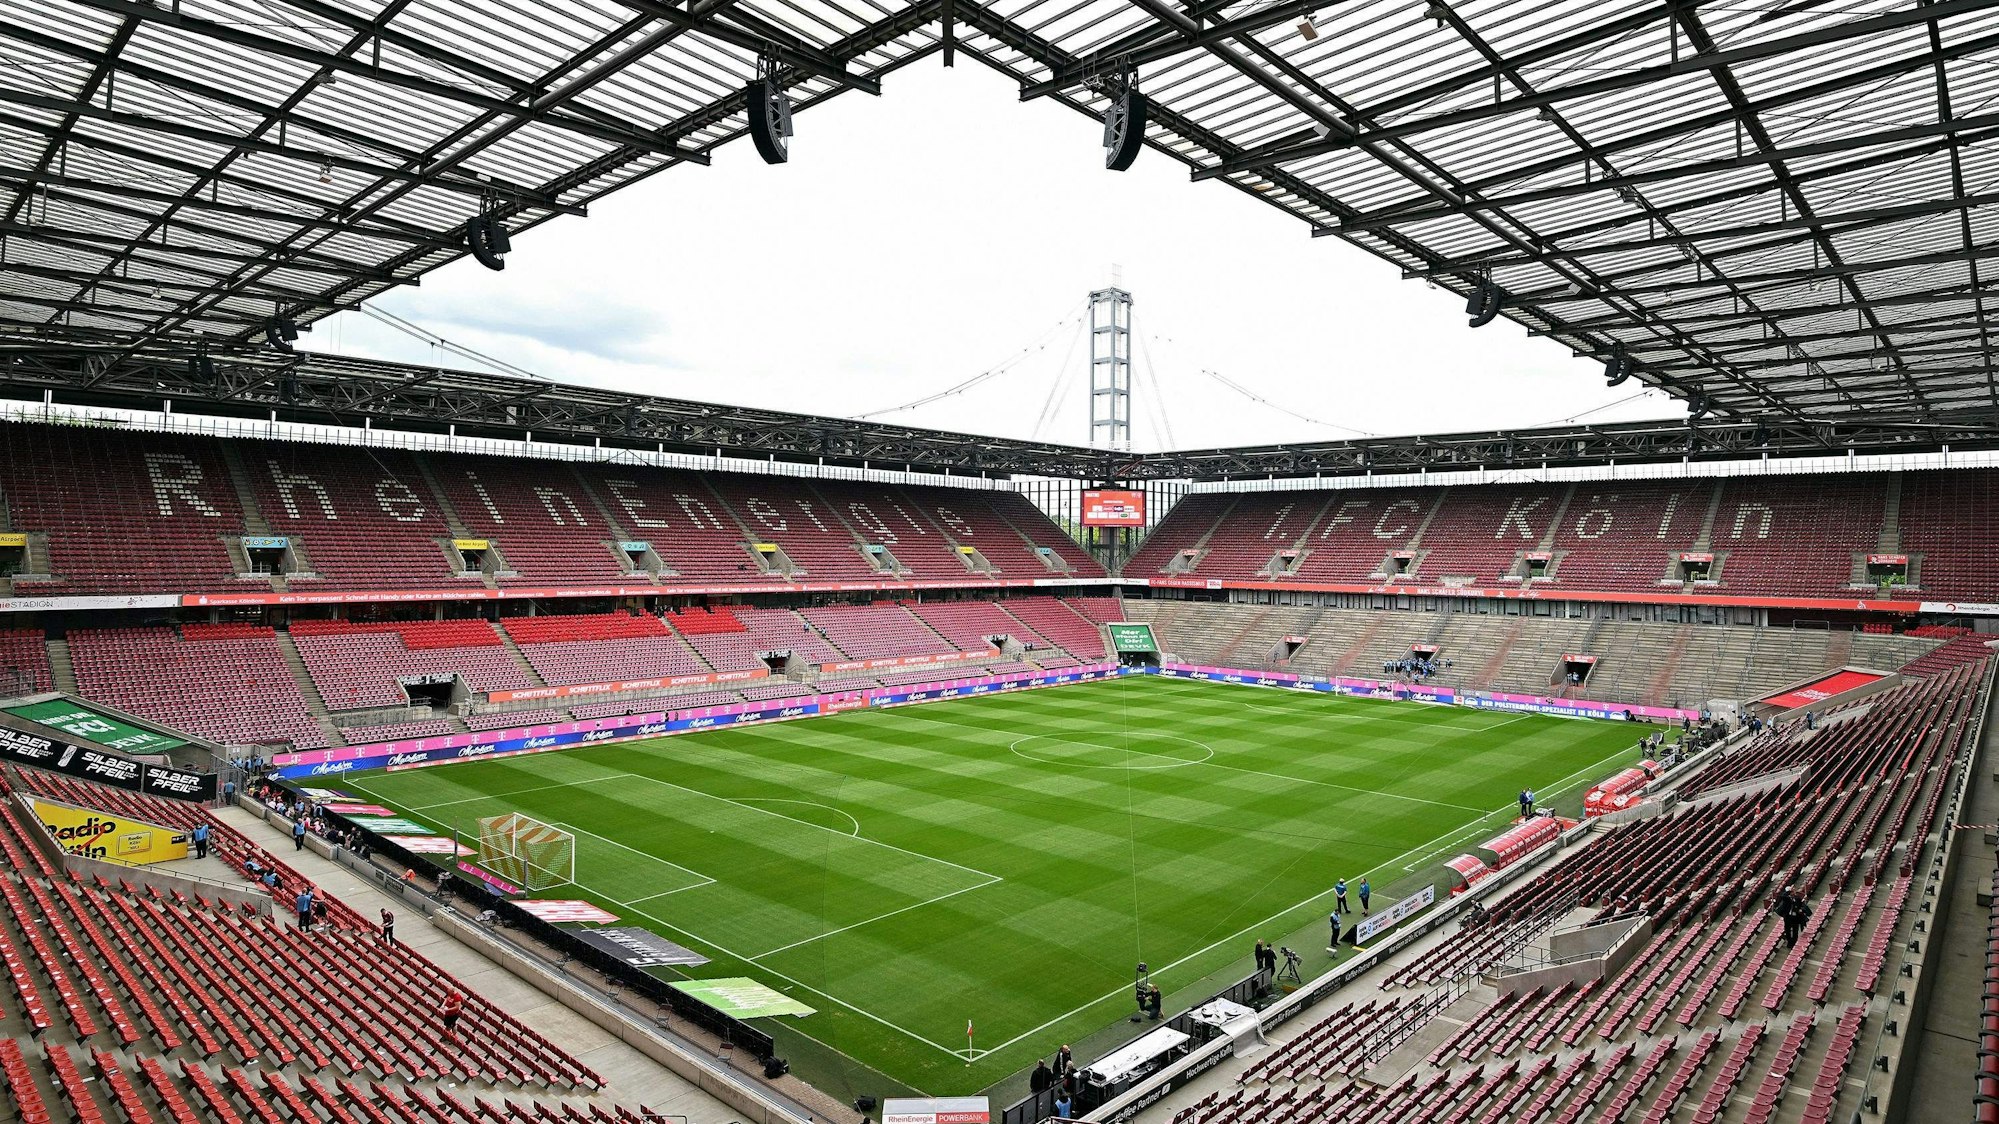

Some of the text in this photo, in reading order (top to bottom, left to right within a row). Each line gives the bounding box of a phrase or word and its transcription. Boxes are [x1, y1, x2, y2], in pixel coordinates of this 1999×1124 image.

[381, 592, 400, 601] Handy
[827, 700, 862, 710] RheinEnergie
[1587, 709, 1606, 719] KÖLN
[0, 729, 51, 750] SILBER
[0, 740, 39, 758] PFEIL
[81, 752, 137, 772] SILBER
[86, 763, 126, 780] PFEIL
[147, 768, 199, 786] SILBER
[152, 779, 190, 793] PFEIL
[1344, 962, 1371, 981] Kaffee Partner
[1186, 1054, 1220, 1079] Hochwertige
[1115, 1091, 1161, 1122] Kaffee Partner
[888, 1113, 983, 1123] RheinEnergie POWERBANK
